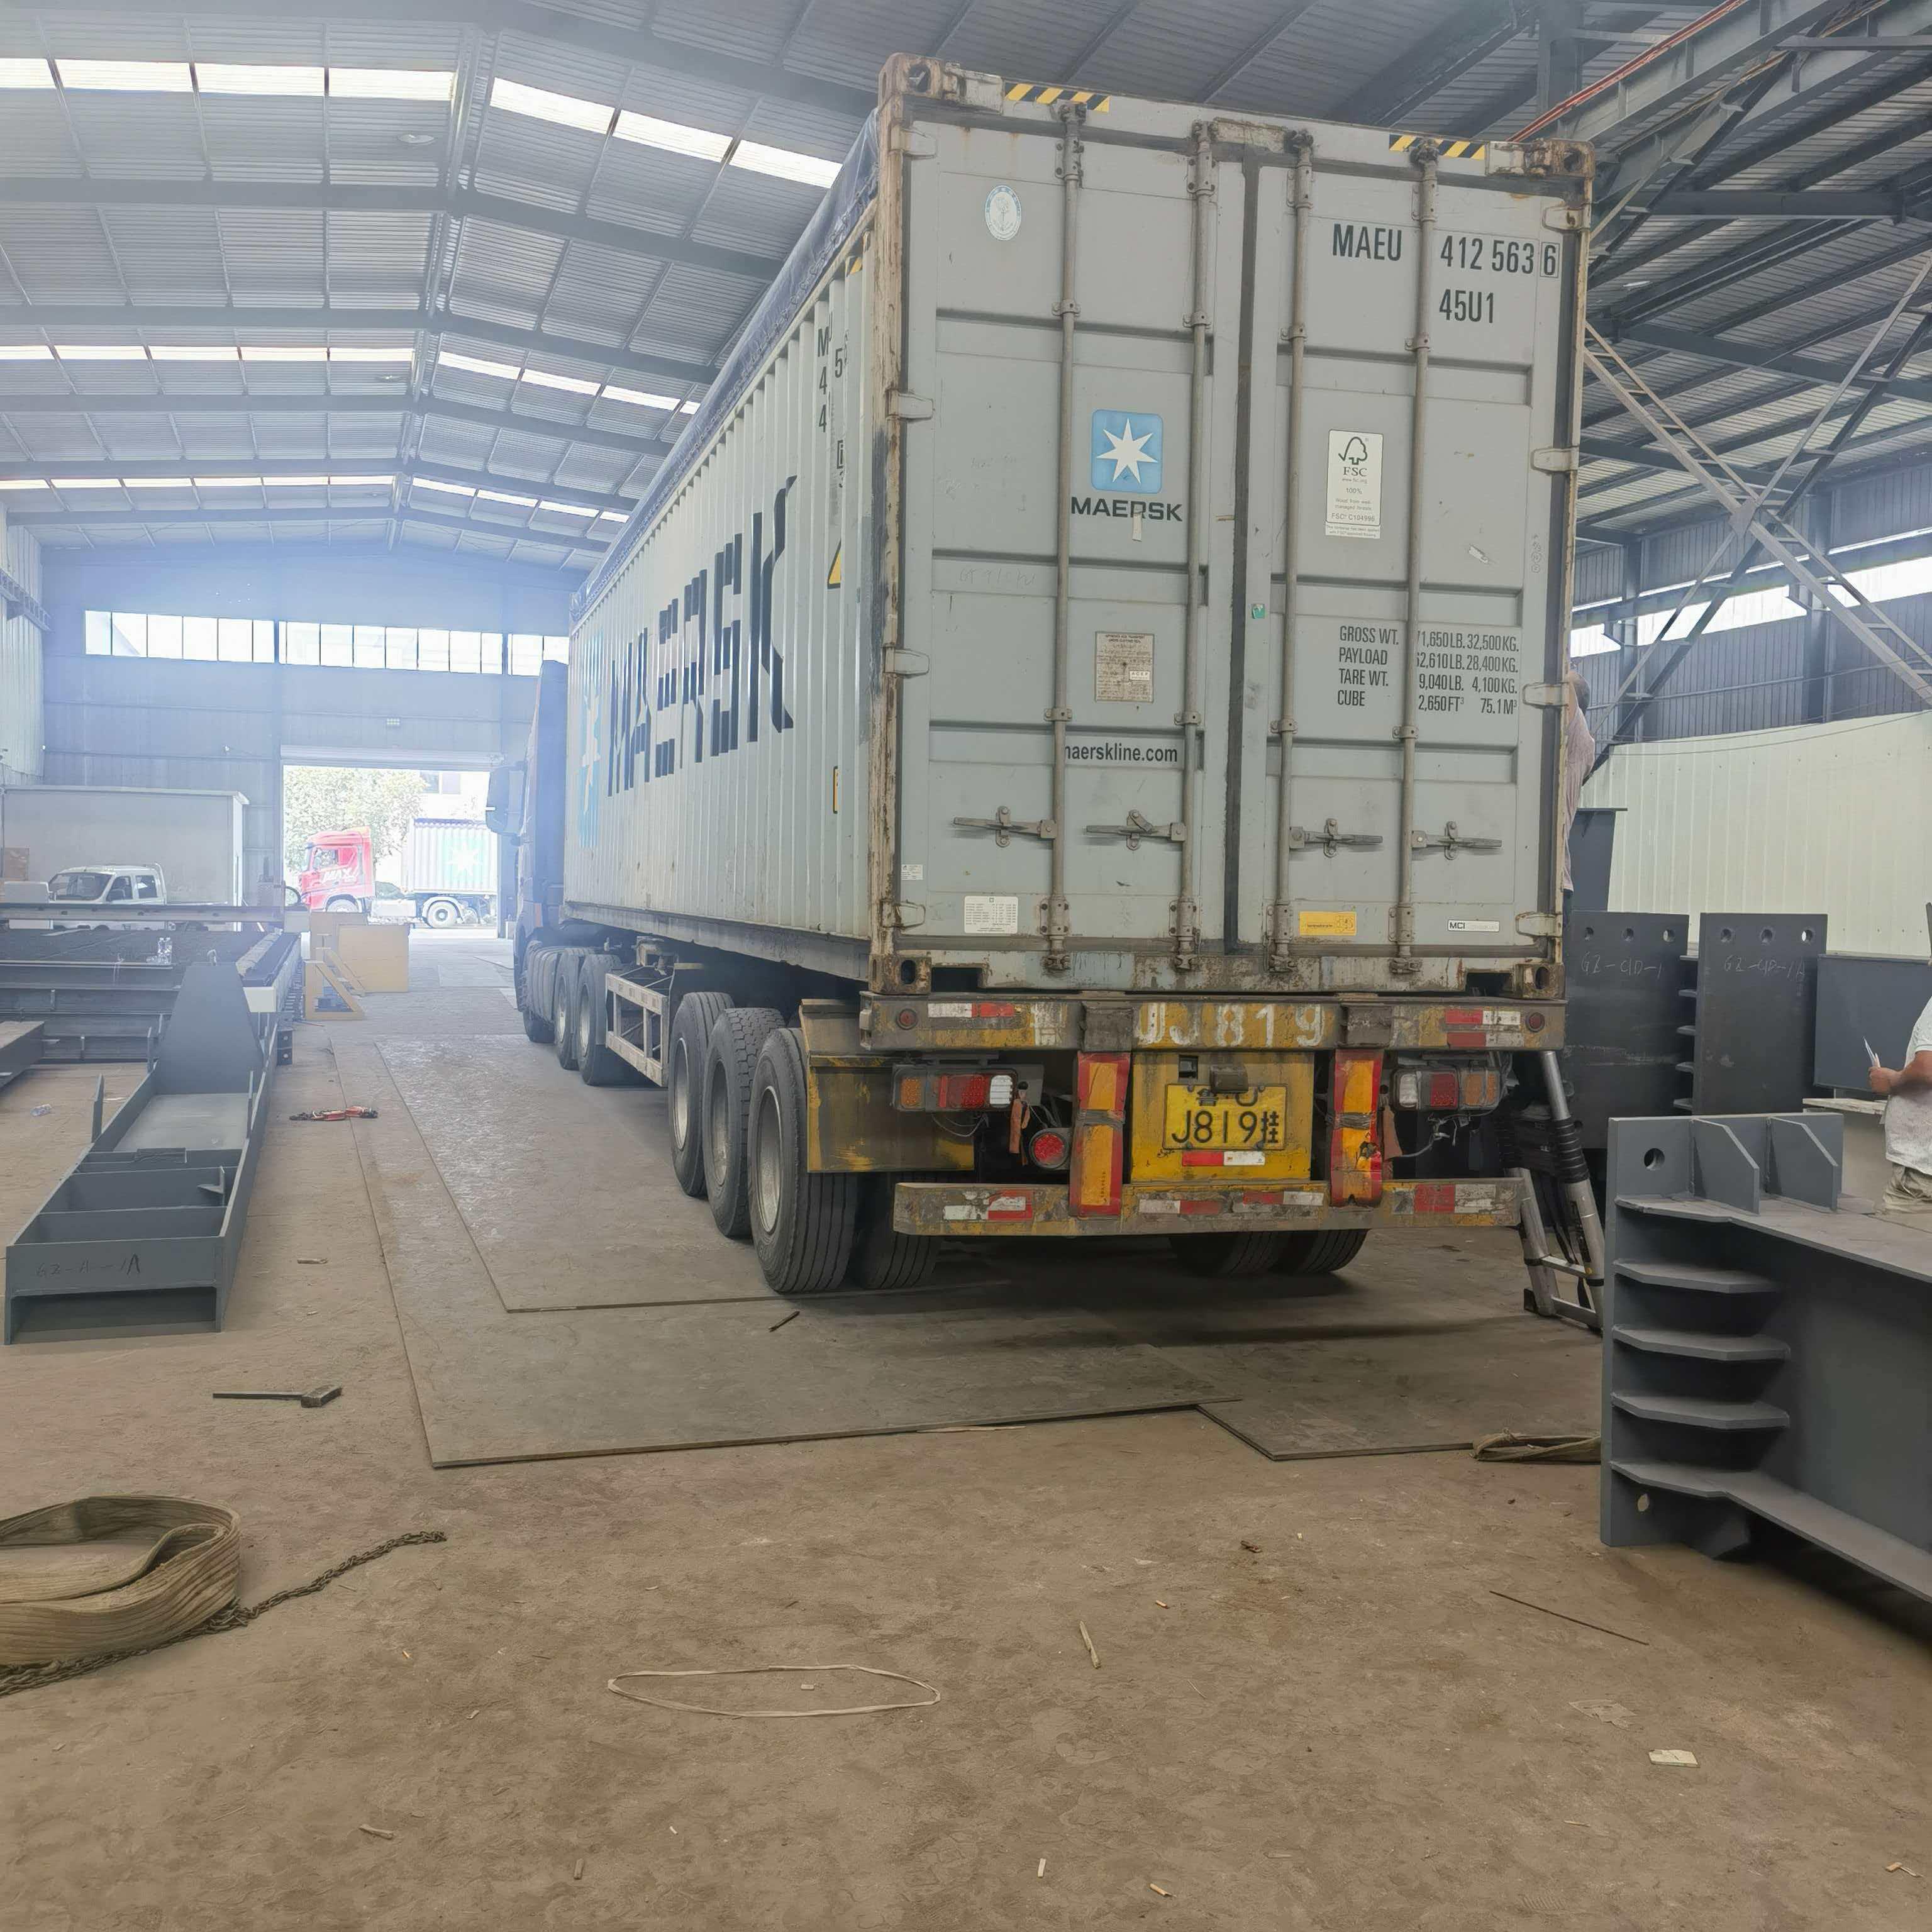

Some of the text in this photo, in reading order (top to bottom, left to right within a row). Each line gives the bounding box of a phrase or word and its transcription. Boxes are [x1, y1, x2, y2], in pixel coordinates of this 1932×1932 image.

[1332, 223, 1557, 275] MAEU 412 563 6
[1439, 289, 1494, 323] 45U1
[1343, 467, 1367, 477] FSC
[1071, 497, 1183, 521] MAERSK
[1340, 626, 1376, 643] GROSS
[1379, 629, 1399, 645] WT.
[1450, 633, 1465, 649] LB.
[1467, 634, 1501, 650] 32,500
[1502, 636, 1519, 652] KG.
[1339, 647, 1388, 665] PAYLOAD
[1450, 653, 1465, 670] LB.
[1467, 655, 1501, 672] 28,400
[1502, 657, 1519, 673] KG.
[1339, 669, 1518, 694] TARE WT. 9,040 LB. 4,100 KG.
[1337, 690, 1365, 706] CUBE
[1418, 695, 1446, 711] 2,650
[1480, 698, 1502, 714] 75.1
[1172, 1109, 1279, 1143] J819挂
